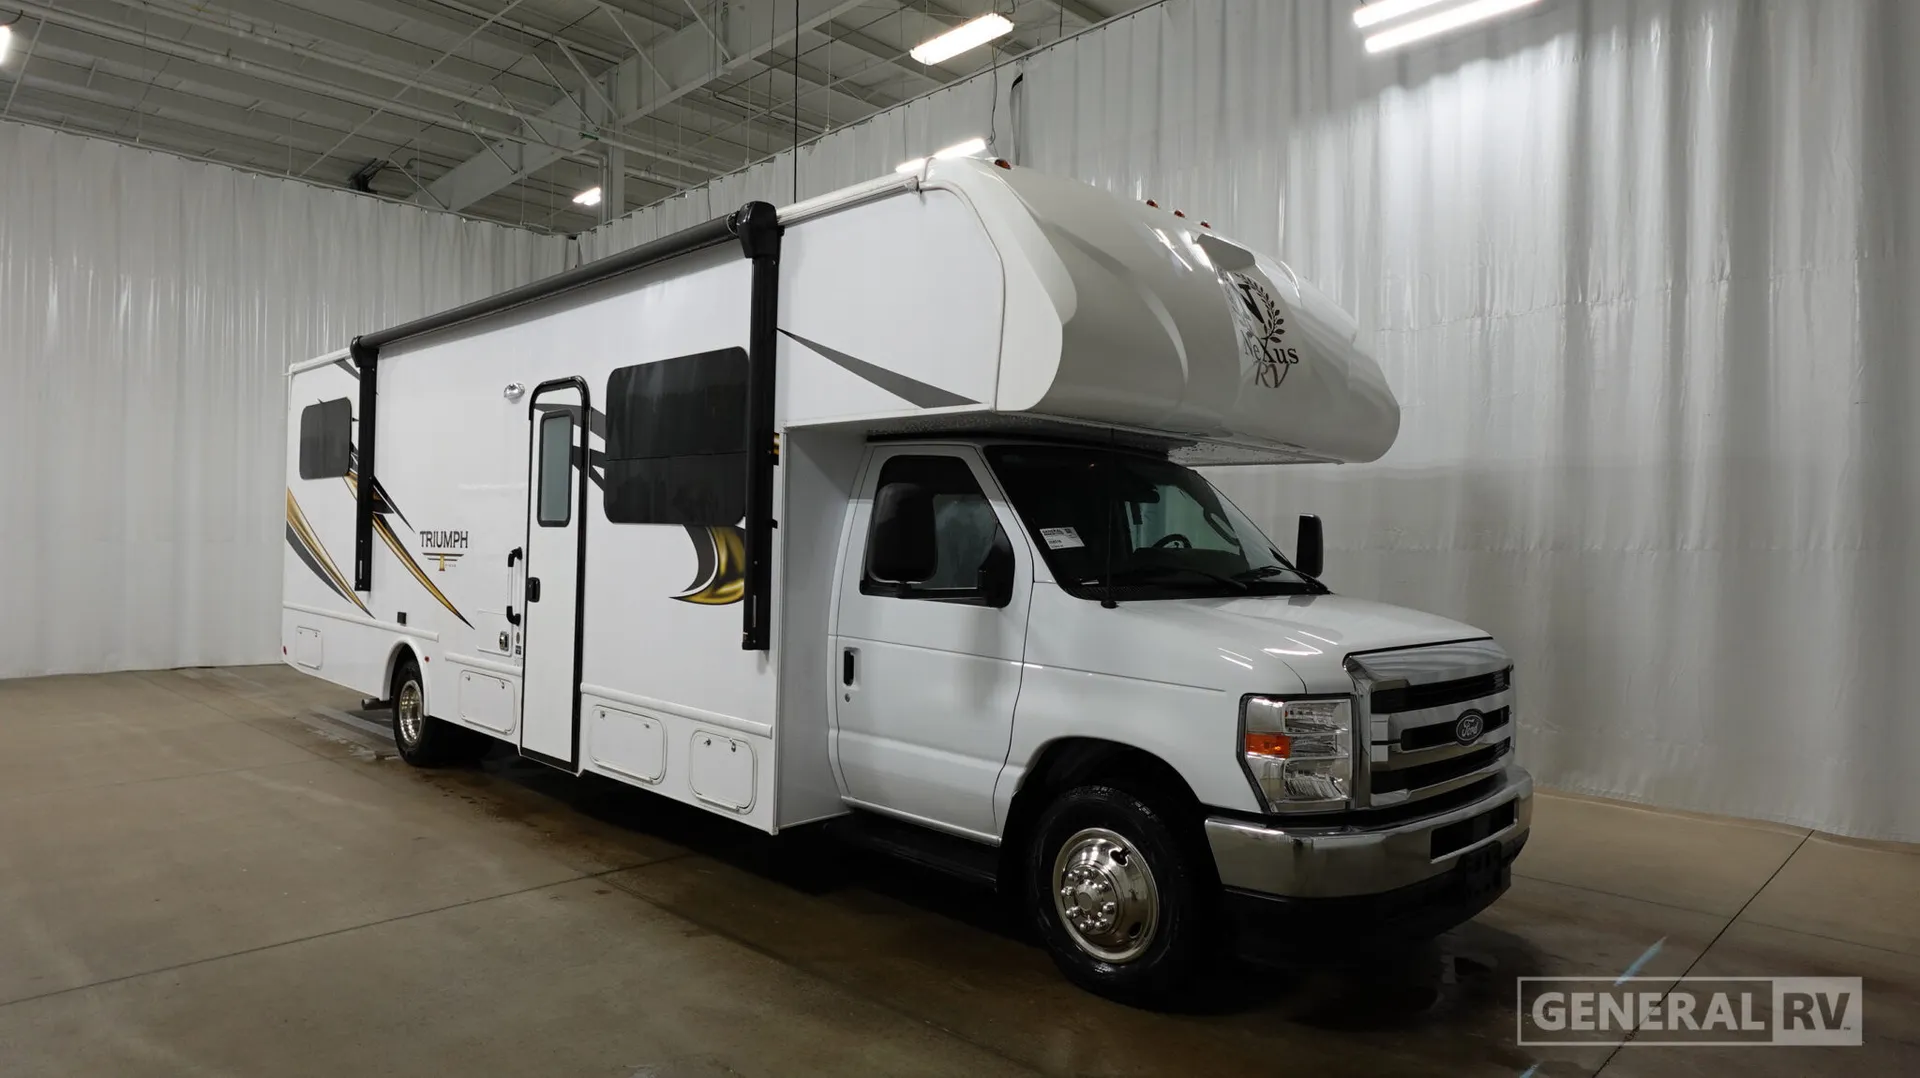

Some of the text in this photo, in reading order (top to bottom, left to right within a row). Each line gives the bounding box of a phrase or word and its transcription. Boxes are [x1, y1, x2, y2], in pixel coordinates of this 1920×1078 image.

[1254, 361, 1290, 388] RV
[419, 530, 468, 548] TRIUMPH
[1461, 718, 1479, 737] Ford
